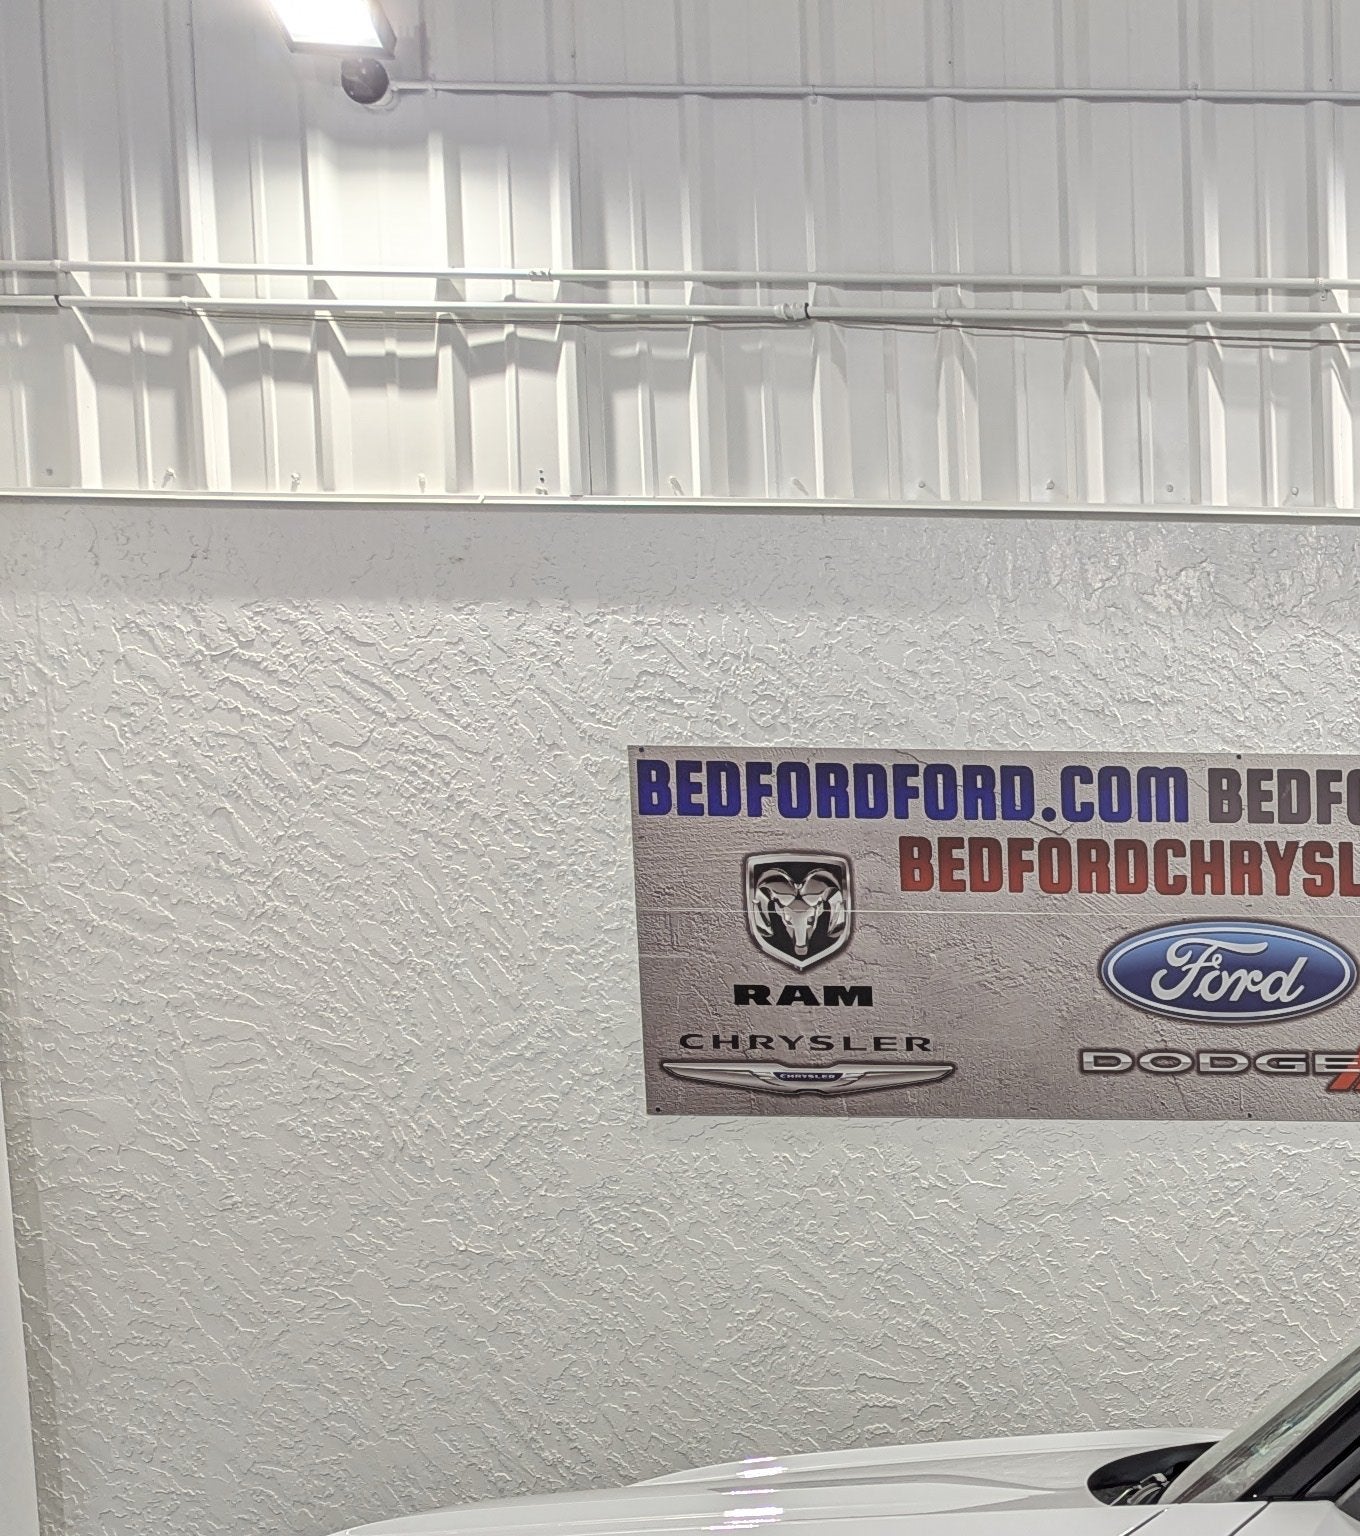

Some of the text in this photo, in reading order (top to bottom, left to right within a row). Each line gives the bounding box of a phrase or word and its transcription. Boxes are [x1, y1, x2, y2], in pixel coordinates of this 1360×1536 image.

[636, 759, 1190, 823] BEDFORDFORD.COM
[1150, 933, 1307, 1003] Ford
[733, 984, 873, 1007] RAM
[679, 1032, 933, 1053] CHRYSLER
[1082, 1050, 1360, 1074] DODGE
